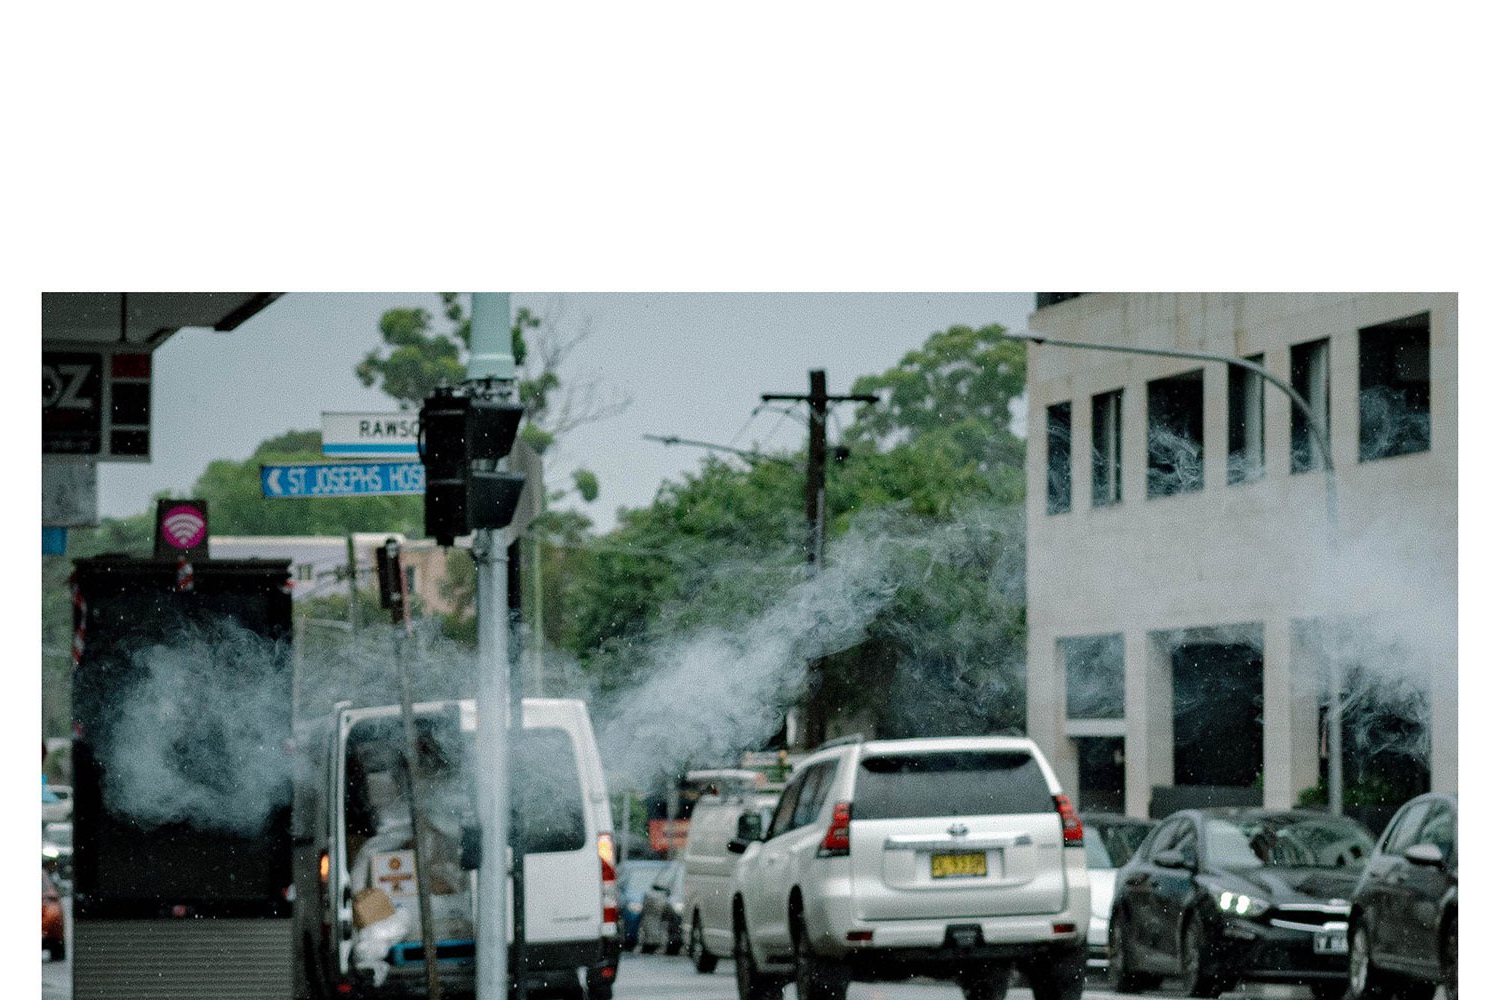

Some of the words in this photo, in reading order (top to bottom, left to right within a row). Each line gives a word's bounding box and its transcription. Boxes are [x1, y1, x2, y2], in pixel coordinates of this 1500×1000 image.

[358, 419, 421, 437] RAWSO
[288, 469, 306, 494] ST
[312, 466, 382, 493] JOSEPHS
[388, 464, 426, 491] HOS
